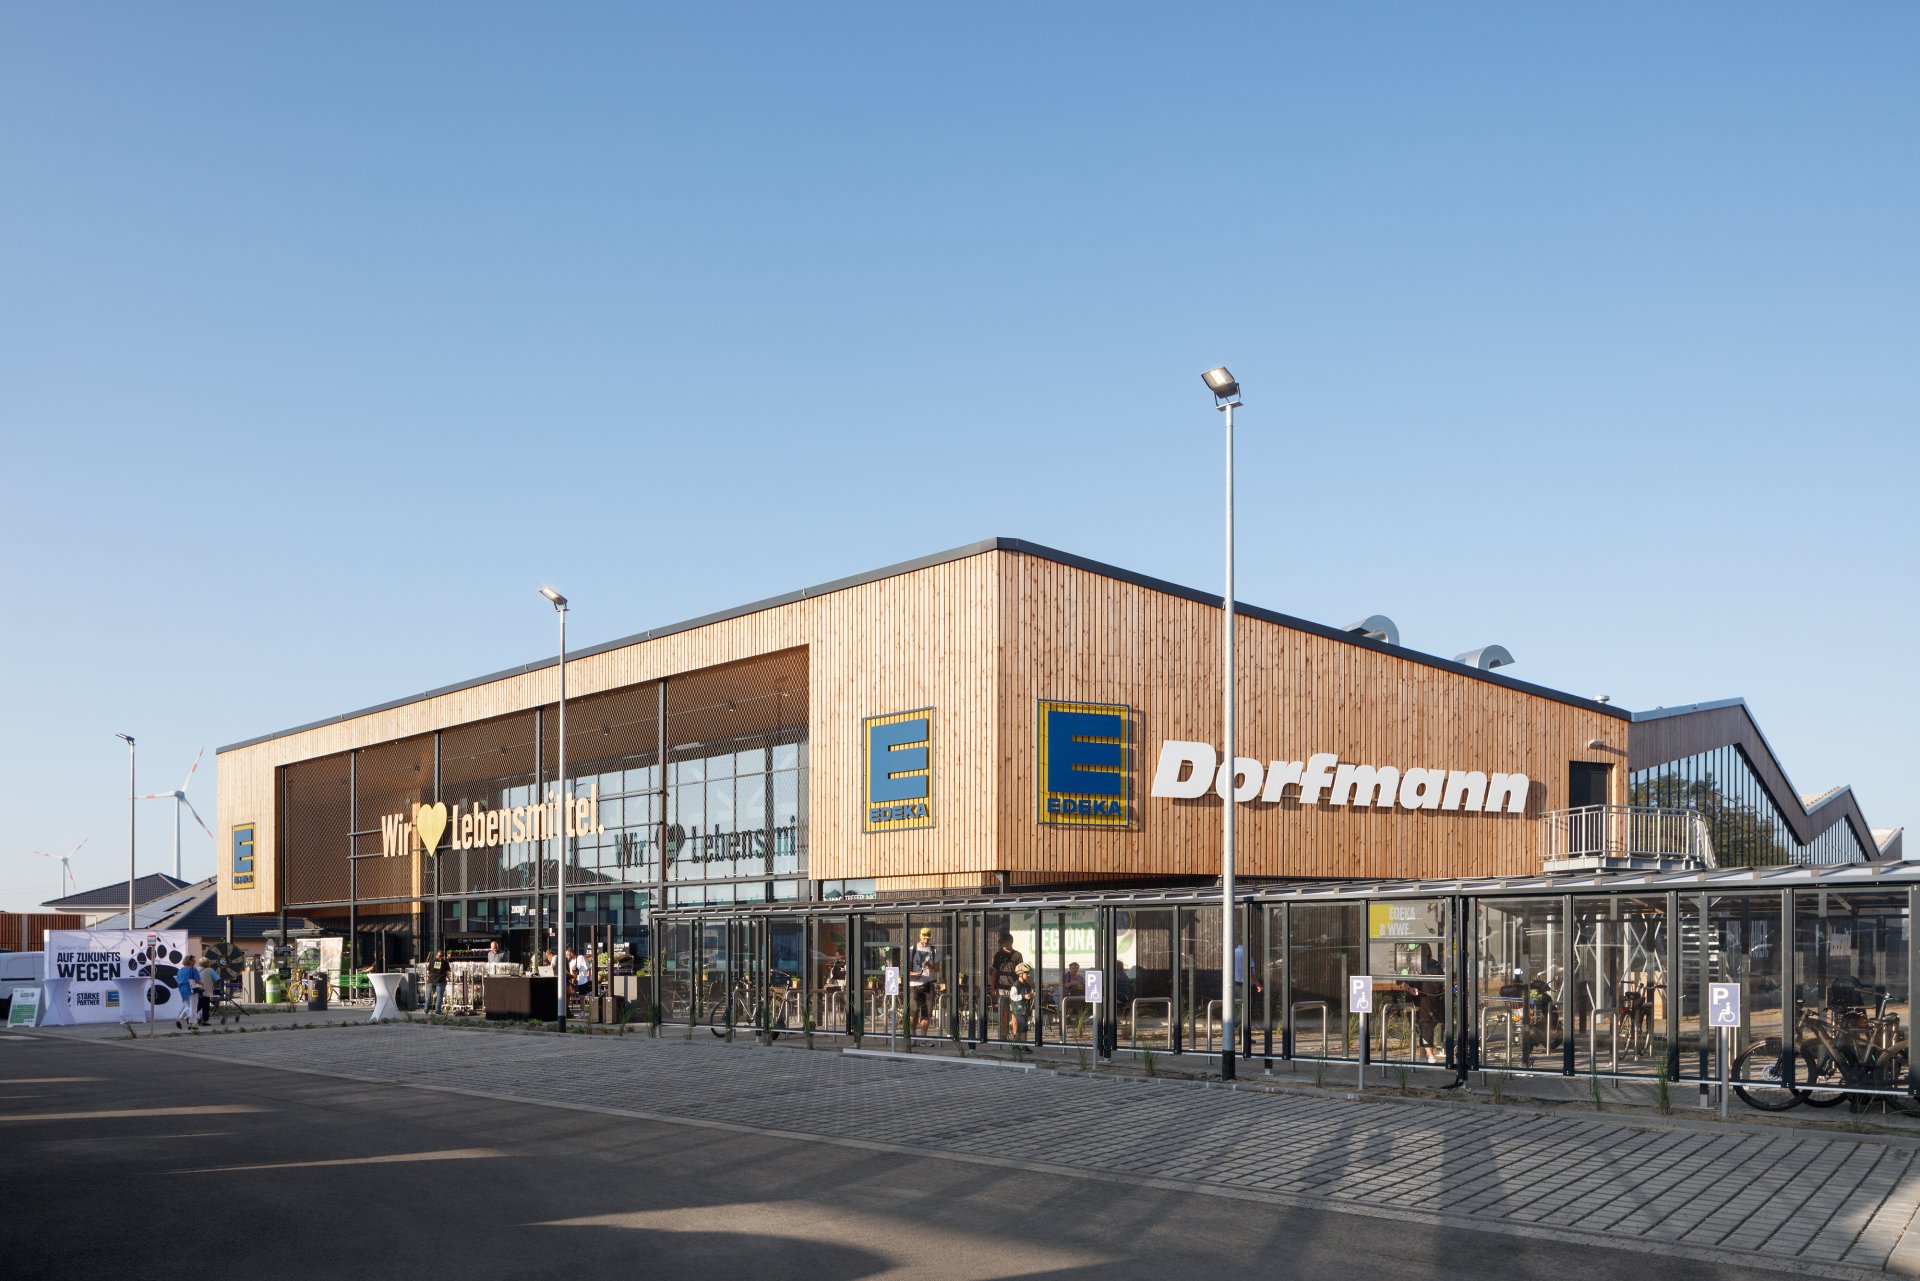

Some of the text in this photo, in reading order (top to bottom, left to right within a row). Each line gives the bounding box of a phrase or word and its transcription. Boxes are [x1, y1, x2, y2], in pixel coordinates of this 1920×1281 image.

[1151, 740, 1530, 813] Dorfmann
[870, 802, 929, 823] EDEKA
[1047, 797, 1121, 816] EDEKA
[381, 812, 413, 858] Wir
[1389, 907, 1416, 920] EDEKA
[1388, 922, 1409, 936] WWF
[57, 951, 120, 963] AUF ZUKUNFTS
[57, 963, 121, 981] WEGEN
[887, 970, 895, 980] P
[1088, 974, 1096, 987] P
[1353, 980, 1363, 993] P
[1713, 988, 1728, 1004] P
